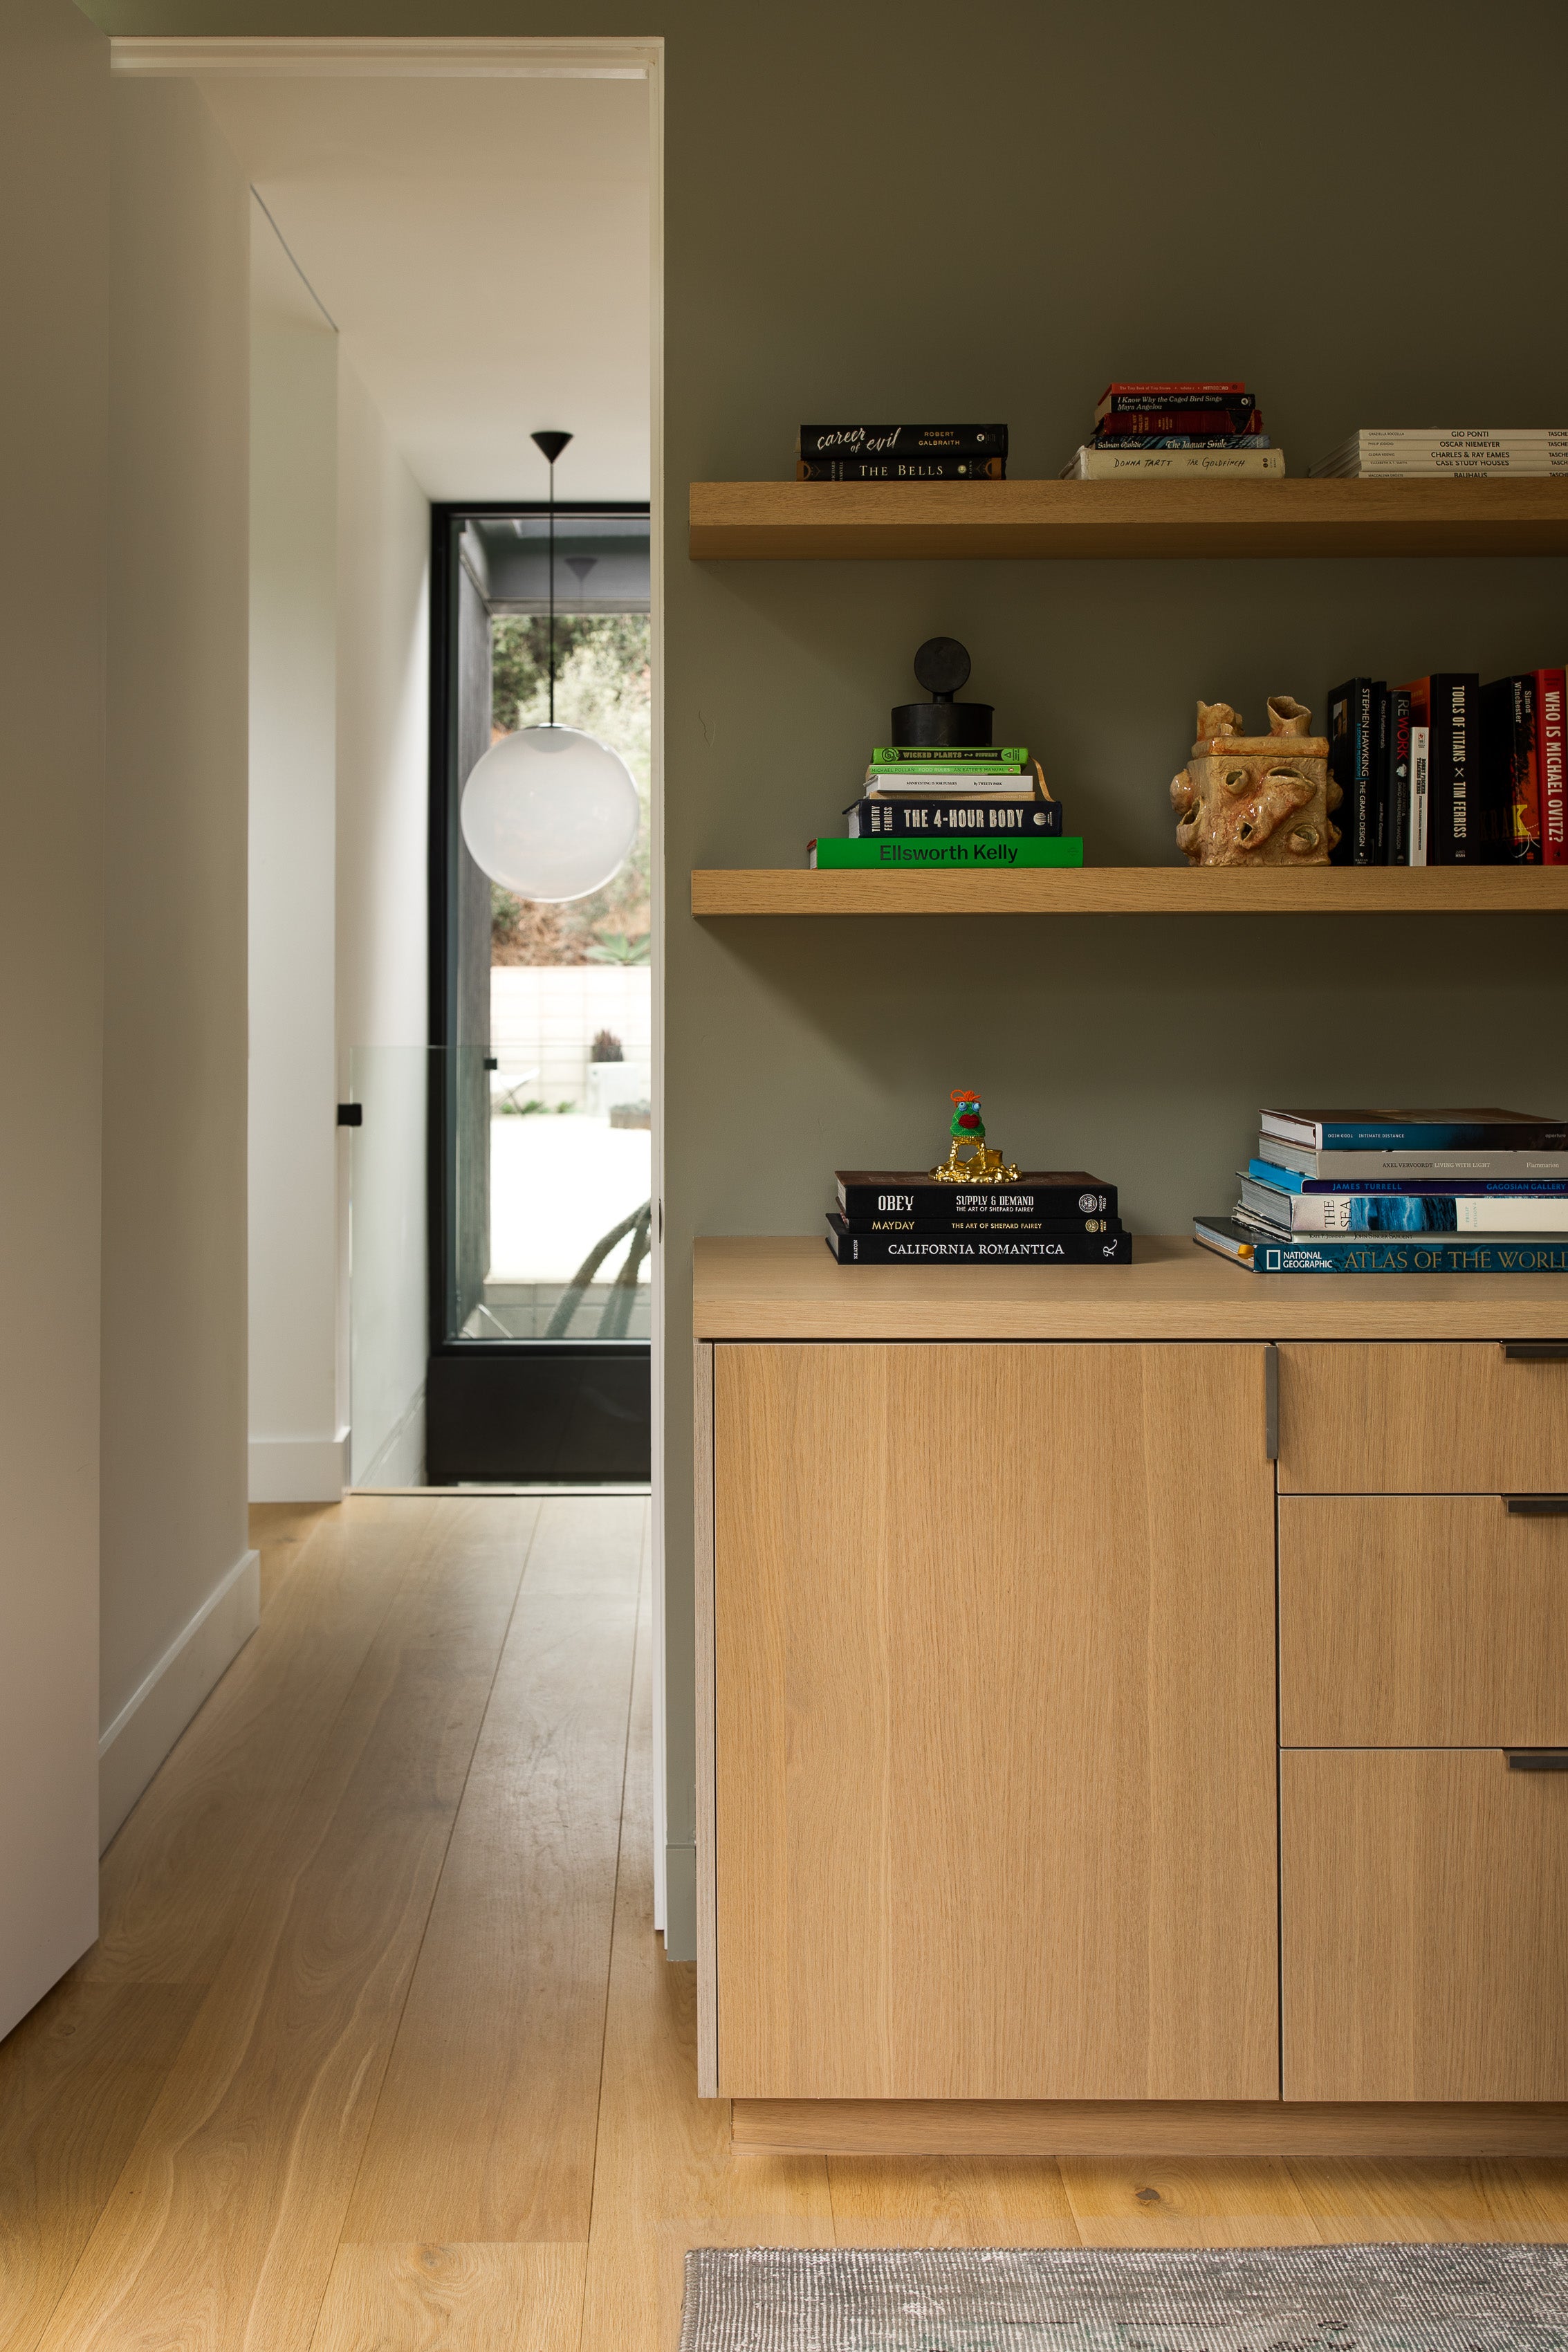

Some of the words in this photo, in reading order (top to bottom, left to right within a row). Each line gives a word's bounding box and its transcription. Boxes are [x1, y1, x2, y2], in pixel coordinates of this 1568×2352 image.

[817, 428, 866, 450] career
[865, 427, 901, 451] evil
[851, 441, 860, 453] of
[1165, 440, 1181, 449] The
[1207, 439, 1227, 448] Smile
[859, 465, 888, 476] THE
[898, 465, 943, 476] BELLS
[1114, 457, 1141, 468] DONNA
[1144, 459, 1173, 468] TARTT
[1362, 688, 1370, 728] STEPHEN
[1452, 686, 1465, 714] TOOLS
[1514, 681, 1523, 724] Winchester
[1545, 690, 1560, 722] WHO
[1397, 699, 1410, 760] REWORK
[1452, 717, 1465, 728] OF
[1546, 726, 1560, 737] IS
[1361, 731, 1369, 777] HAWKING
[1452, 731, 1466, 762] TITANS
[1546, 742, 1562, 796] MICHAEL
[1453, 782, 1466, 798] TIM
[871, 805, 880, 832] TIMOTHY
[884, 807, 893, 831] FERRISS
[903, 809, 929, 828] THE
[933, 809, 985, 828] 4-HOUR
[989, 809, 1024, 828] BODY
[1453, 801, 1466, 838] FERRISS
[1548, 799, 1563, 843] OVITZ?
[880, 844, 968, 861] Ellsworth
[974, 844, 1018, 863] Kelly
[878, 1195, 915, 1211] OBEY
[956, 1195, 988, 1206] SUPPLY
[999, 1195, 1034, 1206] DEMAND
[1323, 1200, 1336, 1228] THE
[1340, 1201, 1352, 1228] SEA
[871, 1221, 916, 1230] MAYDAY
[888, 1244, 975, 1255] CALIFORNIA
[979, 1244, 1065, 1254] ROMANTICA
[1283, 1251, 1322, 1260] NATIONAL
[1283, 1260, 1333, 1269] GEOGRAPHIC
[1345, 1251, 1408, 1269] ATLAS
[1414, 1251, 1442, 1269] OF
[1448, 1251, 1492, 1269] THE
